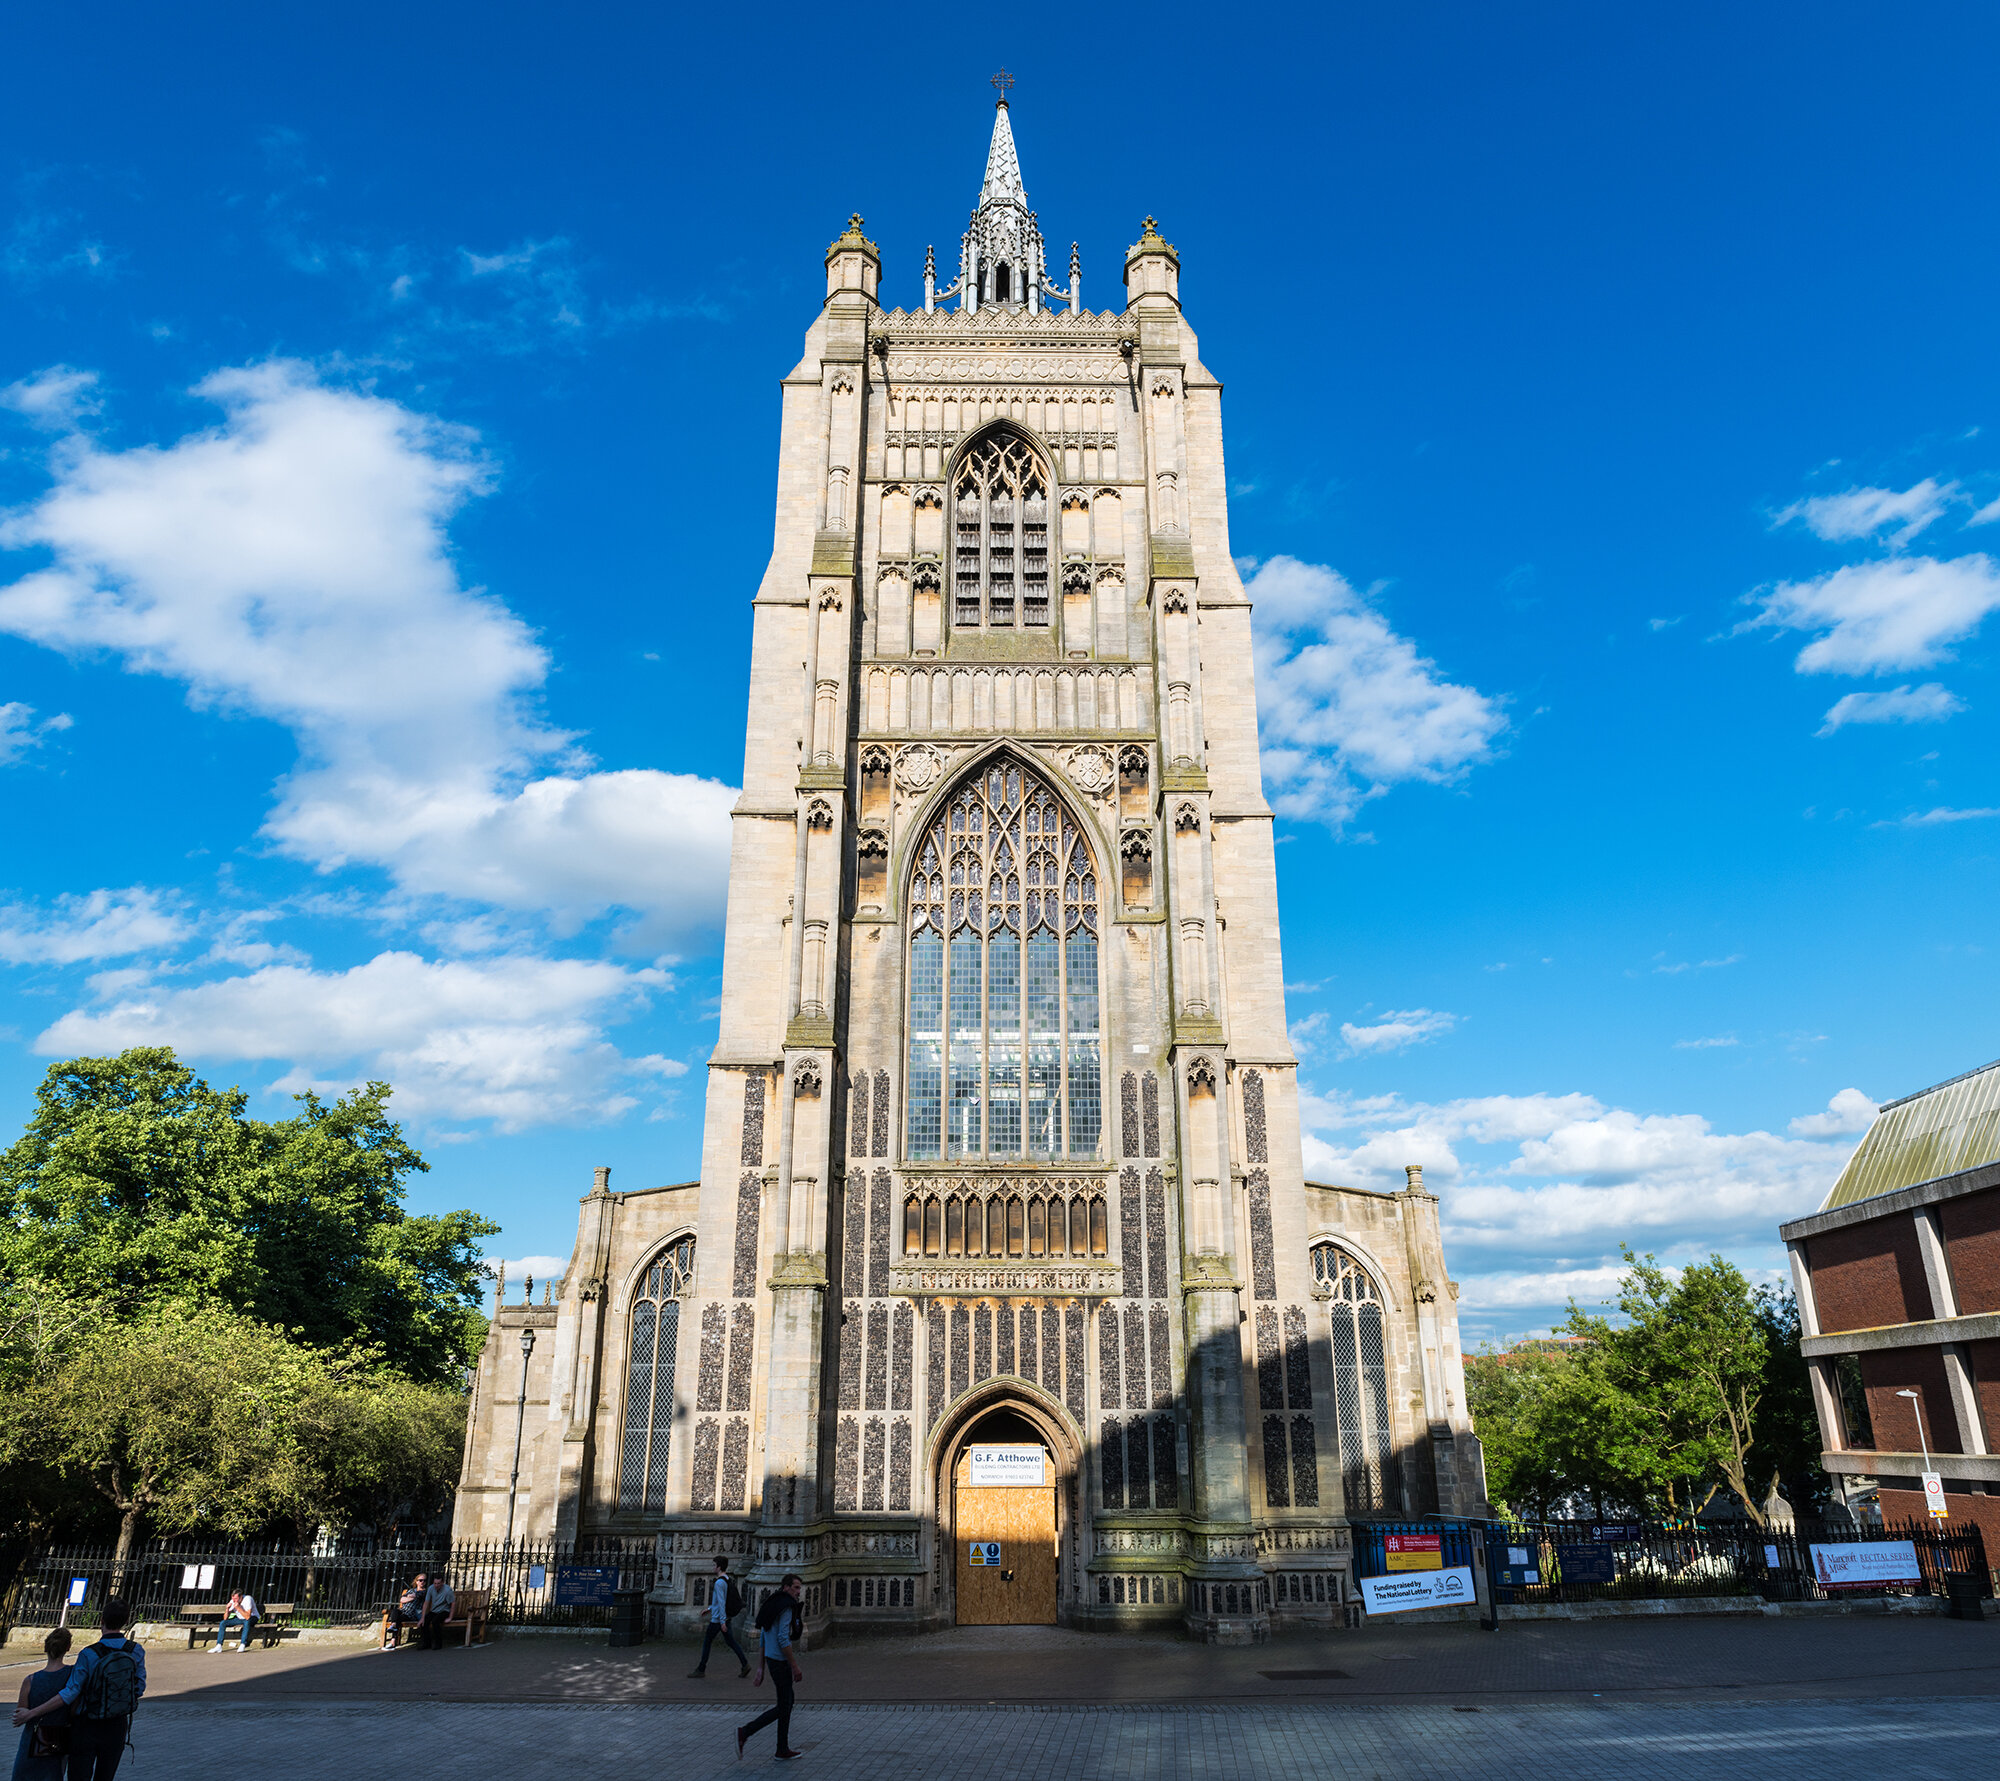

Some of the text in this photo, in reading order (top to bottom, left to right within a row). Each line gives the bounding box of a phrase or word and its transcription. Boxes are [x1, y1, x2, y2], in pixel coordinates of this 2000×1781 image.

[975, 1454, 1040, 1462] G.F. Atthowe
[1826, 1552, 1857, 1563] Mancroft
[1829, 1564, 1848, 1574] Music
[1387, 1589, 1411, 1598] National
[1411, 1586, 1432, 1596] Lottery
